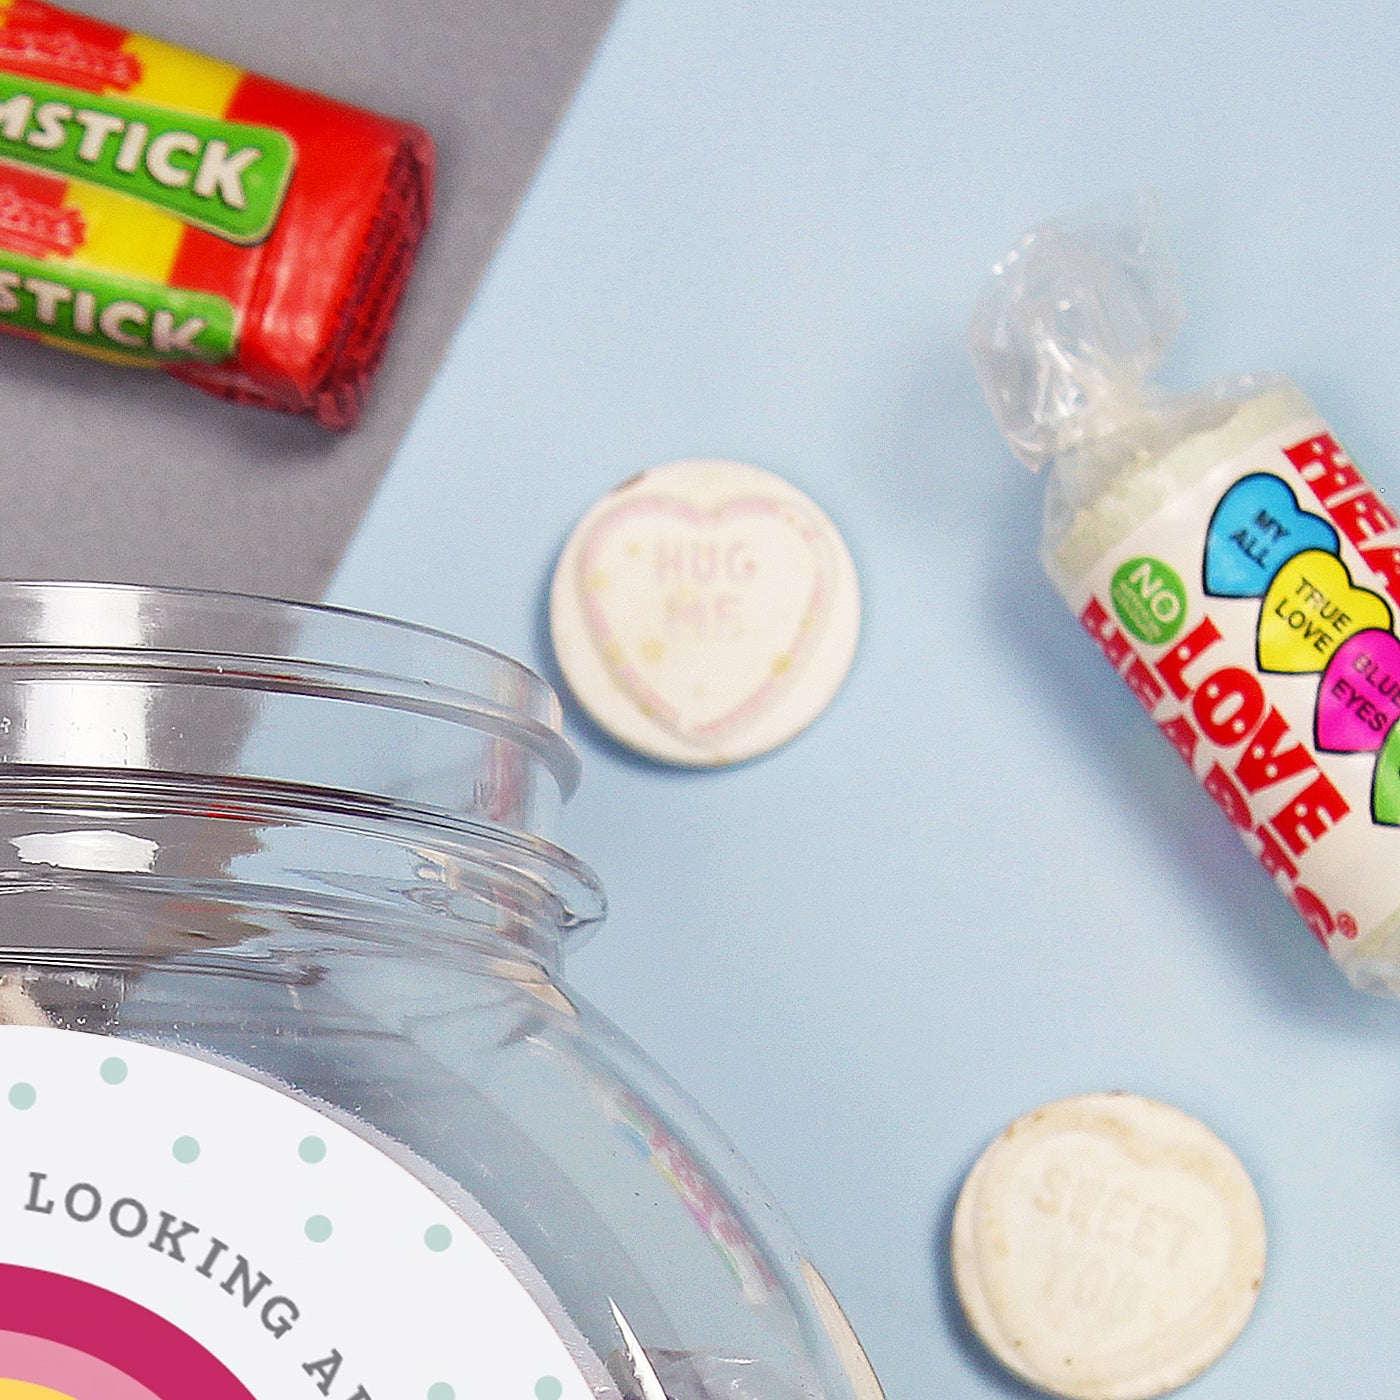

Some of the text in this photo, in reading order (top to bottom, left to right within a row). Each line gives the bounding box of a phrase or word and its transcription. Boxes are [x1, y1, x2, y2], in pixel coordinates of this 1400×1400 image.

[1229, 527, 1271, 569] ALL
[1255, 508, 1290, 542] MY
[653, 539, 757, 585] HUG
[664, 592, 744, 641] ME
[1130, 562, 1181, 622] NO
[1294, 576, 1352, 633] TRUE
[1275, 598, 1332, 653] LOVE
[1331, 679, 1388, 731] EYES
[1157, 614, 1352, 857] LOVE
[25, 1172, 299, 1339] LOOKING
